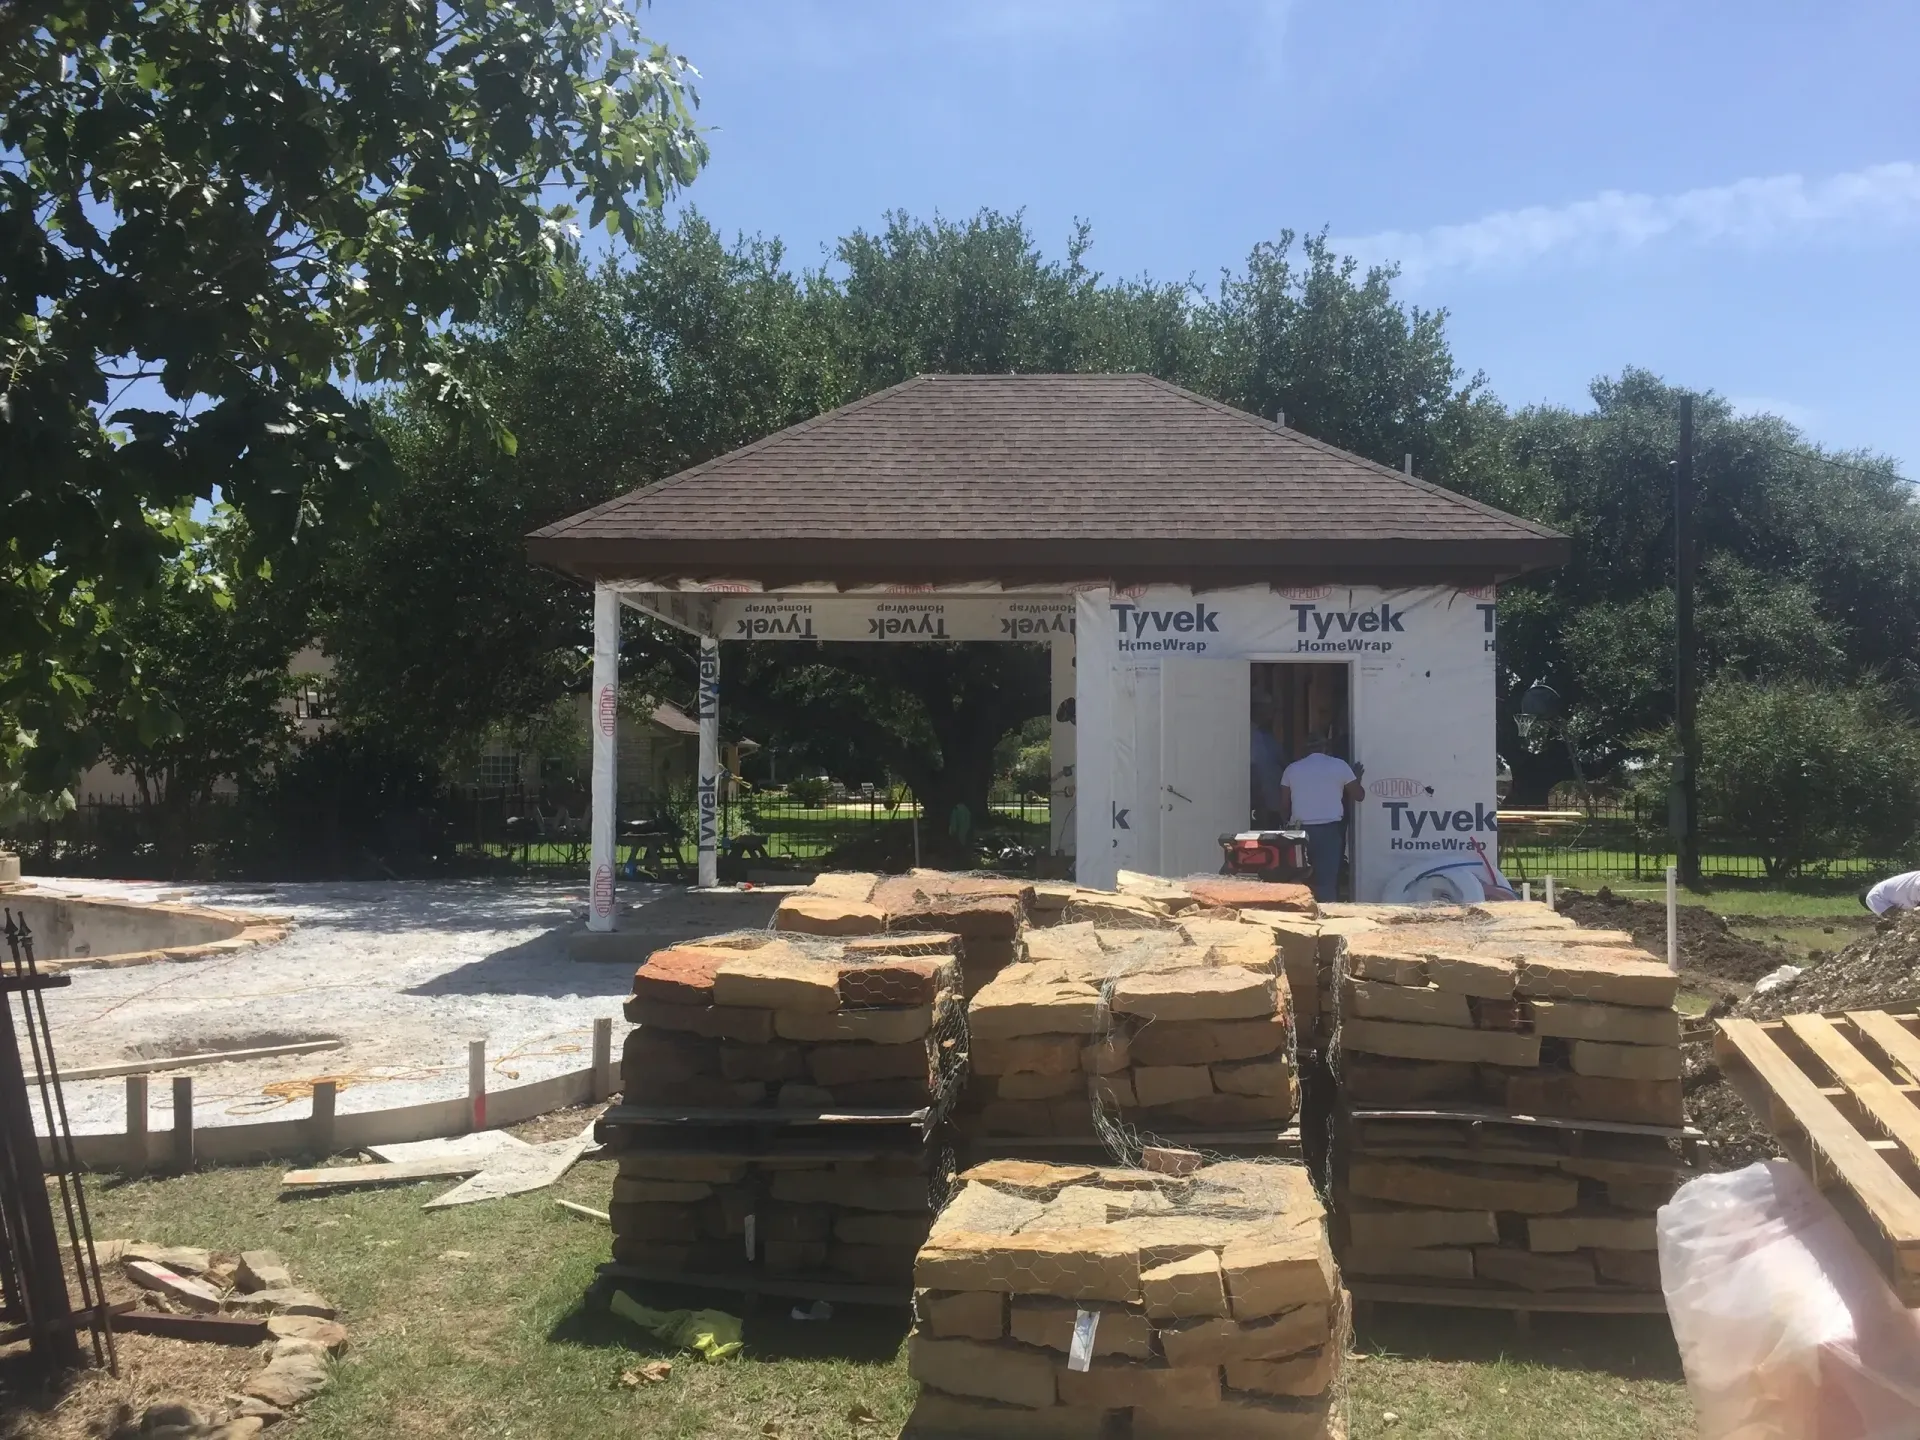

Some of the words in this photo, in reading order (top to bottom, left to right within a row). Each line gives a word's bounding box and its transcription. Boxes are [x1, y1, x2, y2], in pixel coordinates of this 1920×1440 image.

[745, 605, 812, 614] HomeWrap
[877, 605, 944, 614] HomeWrap
[1110, 603, 1220, 639] Tyvek
[1290, 603, 1405, 640] Tyvek
[737, 613, 818, 639] Tyvek
[868, 613, 950, 639] Tyvek
[1298, 639, 1392, 653] HomeWrap
[1382, 802, 1497, 838] Tyvek
[1391, 838, 1487, 851] HomeWrap
